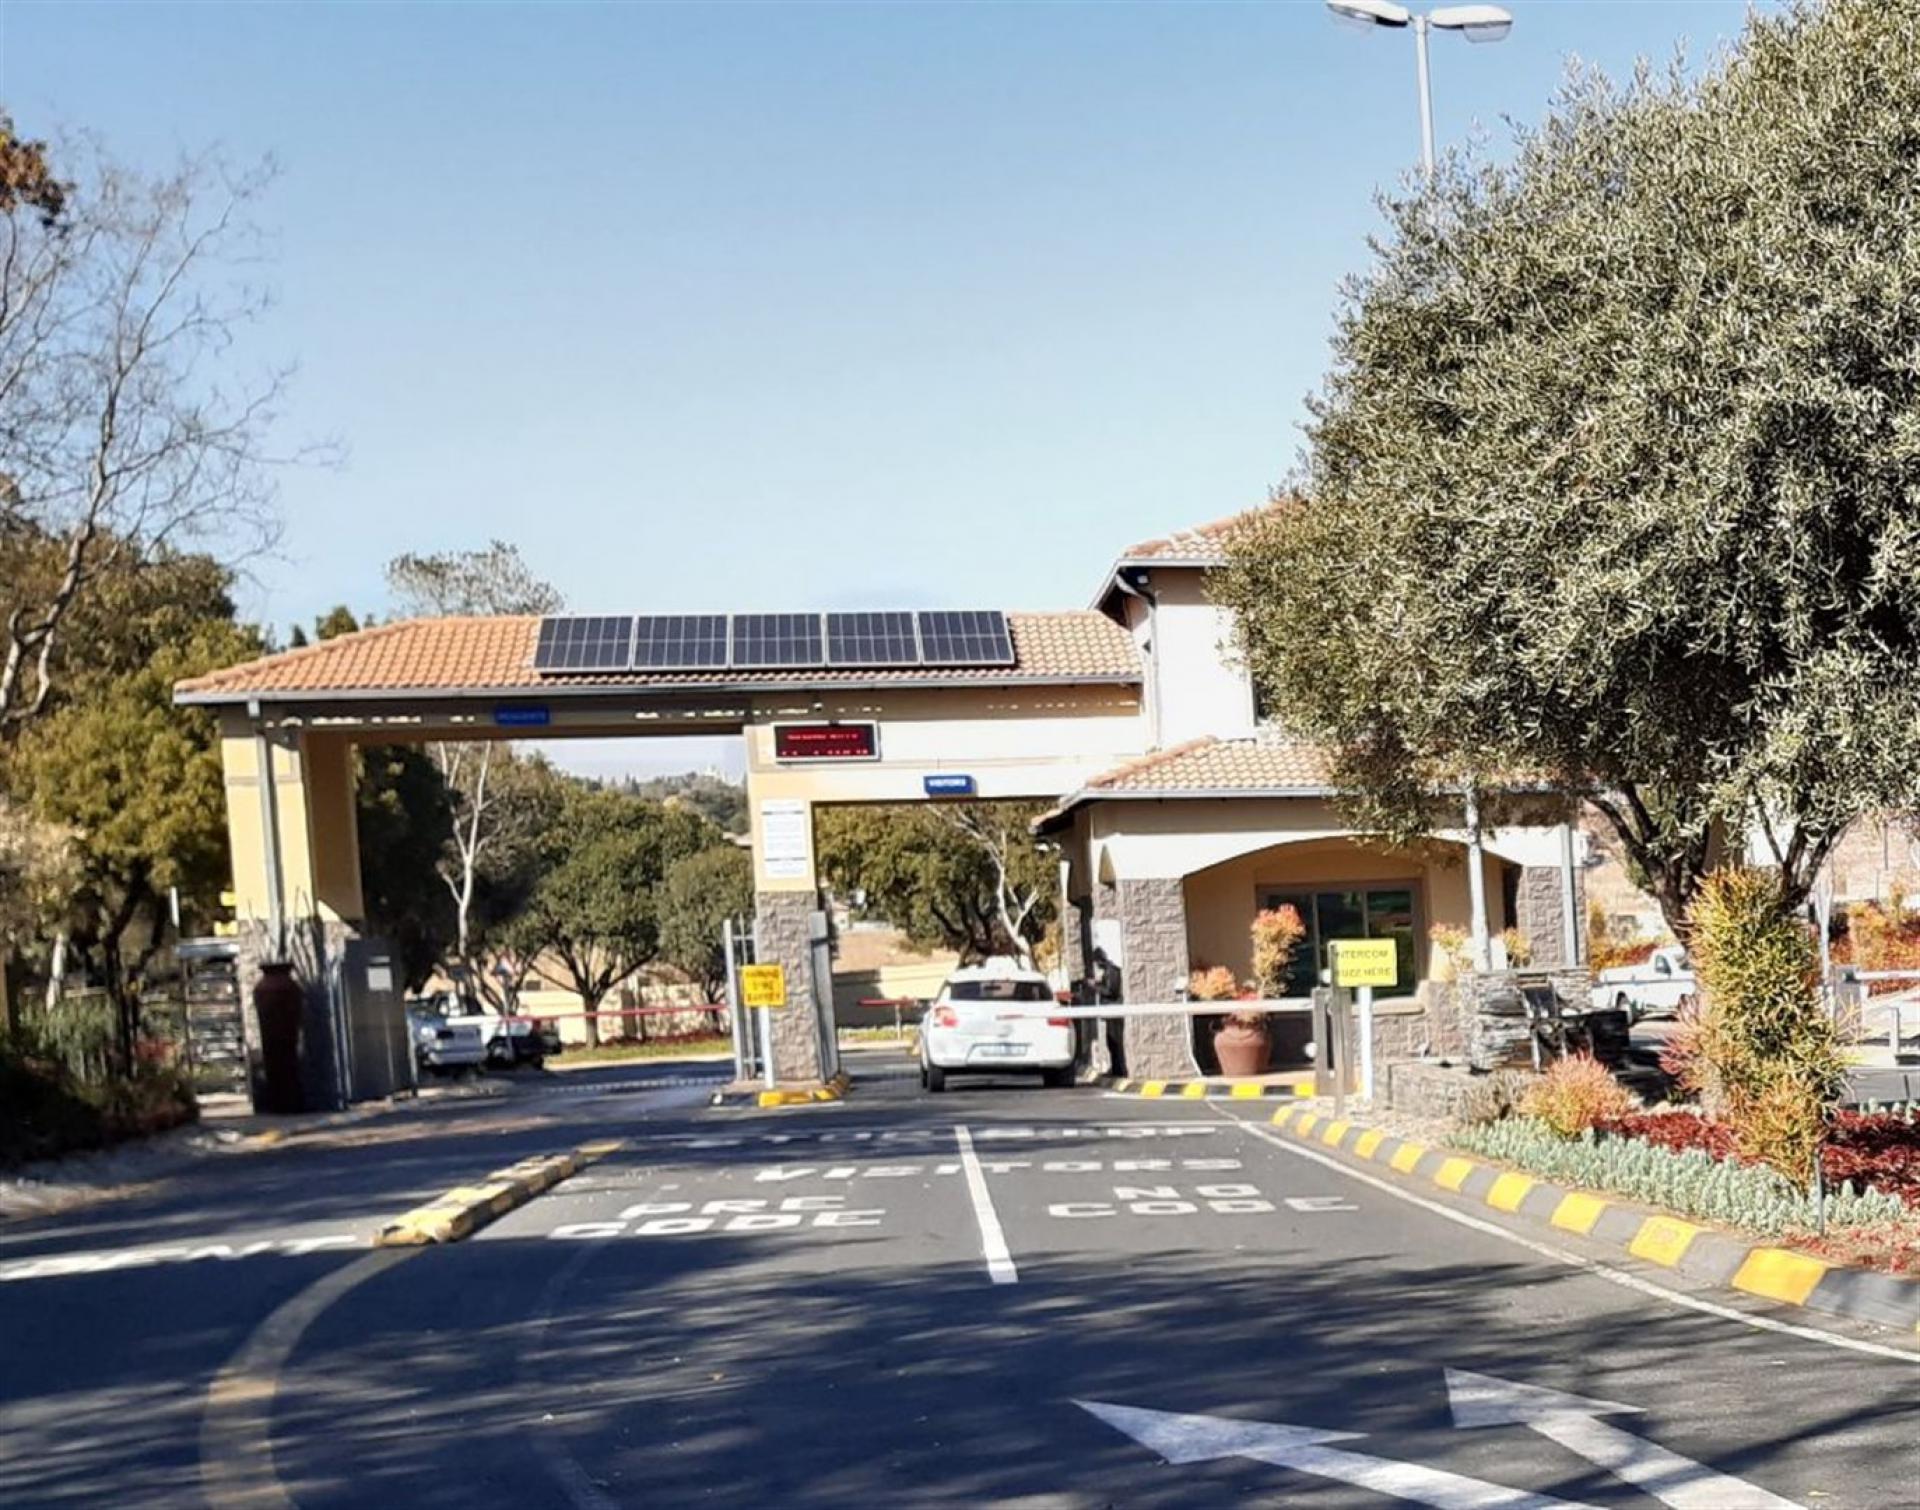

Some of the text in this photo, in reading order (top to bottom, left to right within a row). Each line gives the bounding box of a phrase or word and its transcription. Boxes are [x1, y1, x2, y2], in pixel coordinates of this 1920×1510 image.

[1335, 949, 1389, 960] NTERCOM
[754, 1159, 1243, 1182] VISITORS
[1113, 1183, 1261, 1199] NO
[618, 1194, 845, 1219] PRE
[1048, 1196, 1359, 1217] CODE
[547, 1209, 887, 1240] CODE
